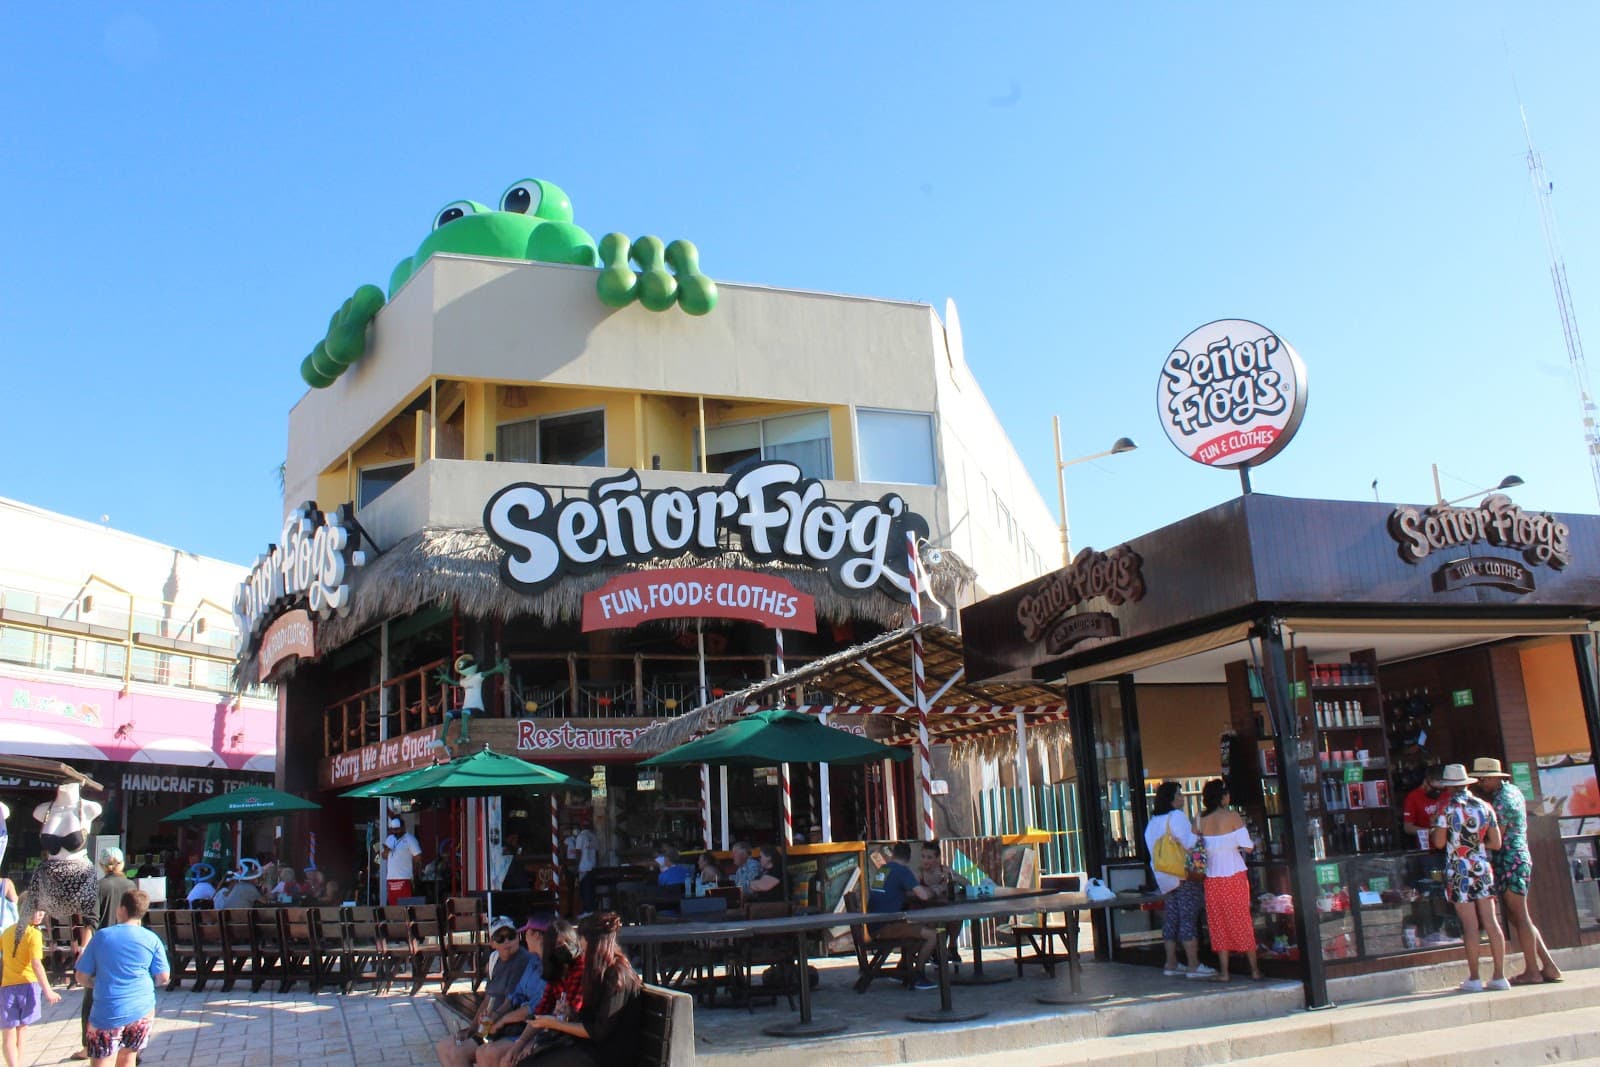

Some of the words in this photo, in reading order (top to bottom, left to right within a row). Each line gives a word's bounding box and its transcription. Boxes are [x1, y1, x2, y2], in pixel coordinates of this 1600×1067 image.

[1164, 336, 1279, 393] Señor
[1169, 369, 1286, 436] Frog's
[1200, 445, 1220, 463] FUN
[1221, 441, 1228, 453] &
[1229, 430, 1275, 450] CLOTHES
[489, 476, 738, 584] Señor
[1400, 505, 1491, 559] Señor
[1484, 561, 1524, 580] CLOTHES
[599, 587, 649, 620] FUN,
[648, 582, 702, 609] FOOD
[704, 584, 714, 604] &
[716, 583, 798, 618] CLOTHES
[331, 754, 360, 785] ¡Sorry
[362, 748, 377, 771] We
[379, 743, 399, 768] Are
[401, 728, 436, 769] Open!
[517, 719, 665, 751] Restaura
[121, 774, 215, 794] HANDCRAFTS
